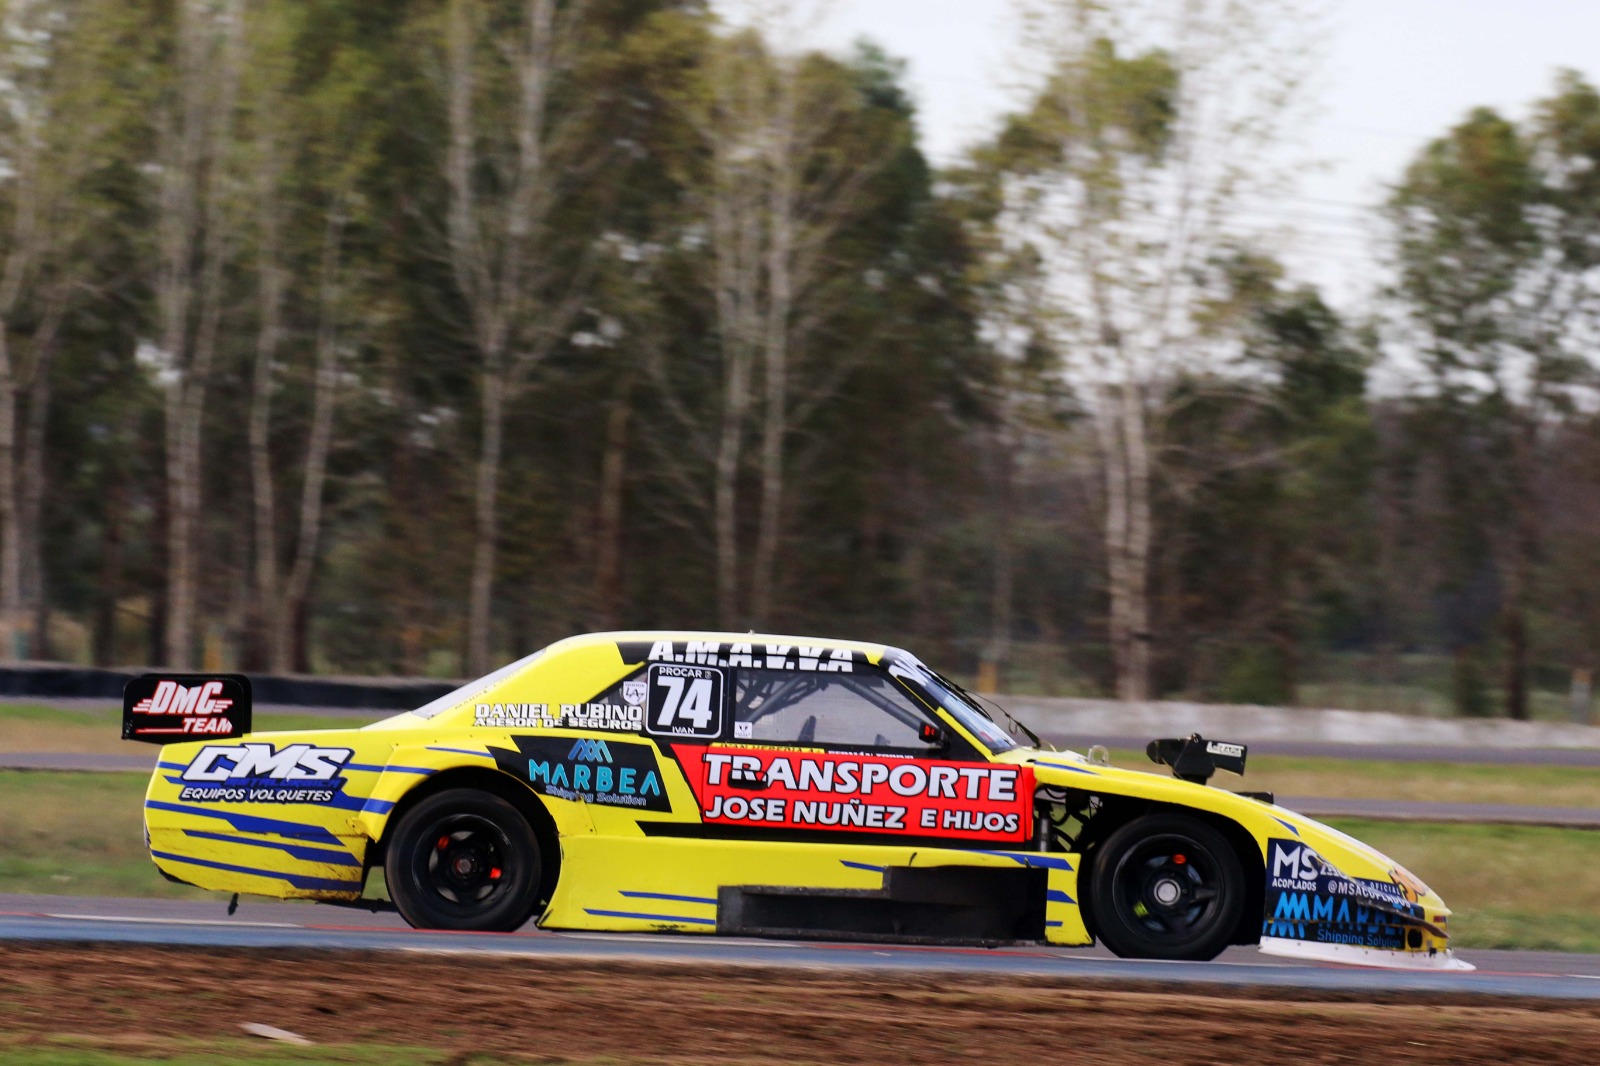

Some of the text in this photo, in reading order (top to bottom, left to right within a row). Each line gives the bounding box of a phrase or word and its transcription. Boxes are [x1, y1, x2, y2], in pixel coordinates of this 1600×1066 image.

[659, 666, 703, 679] PROCAR
[148, 681, 223, 715] DMC
[657, 675, 713, 729] 74
[475, 703, 644, 721] DANIEL RUBINO
[182, 717, 233, 734] TEAM
[474, 717, 538, 729] ASESOR
[568, 718, 643, 731] SEGUROS
[672, 726, 695, 735] IVAN
[181, 743, 353, 783] CMS
[528, 758, 661, 797] MARBEA
[703, 753, 1017, 802] TRANSPORTE
[181, 787, 334, 802] EQUIPOS VOLQUETES
[545, 784, 647, 806] Shipping Solution
[705, 796, 1018, 833] JOSE NUÑEZ E HIJOS
[1273, 842, 1320, 881] MS
[1272, 877, 1317, 892] ACOPLADOS
[1317, 929, 1364, 945] Shipping
